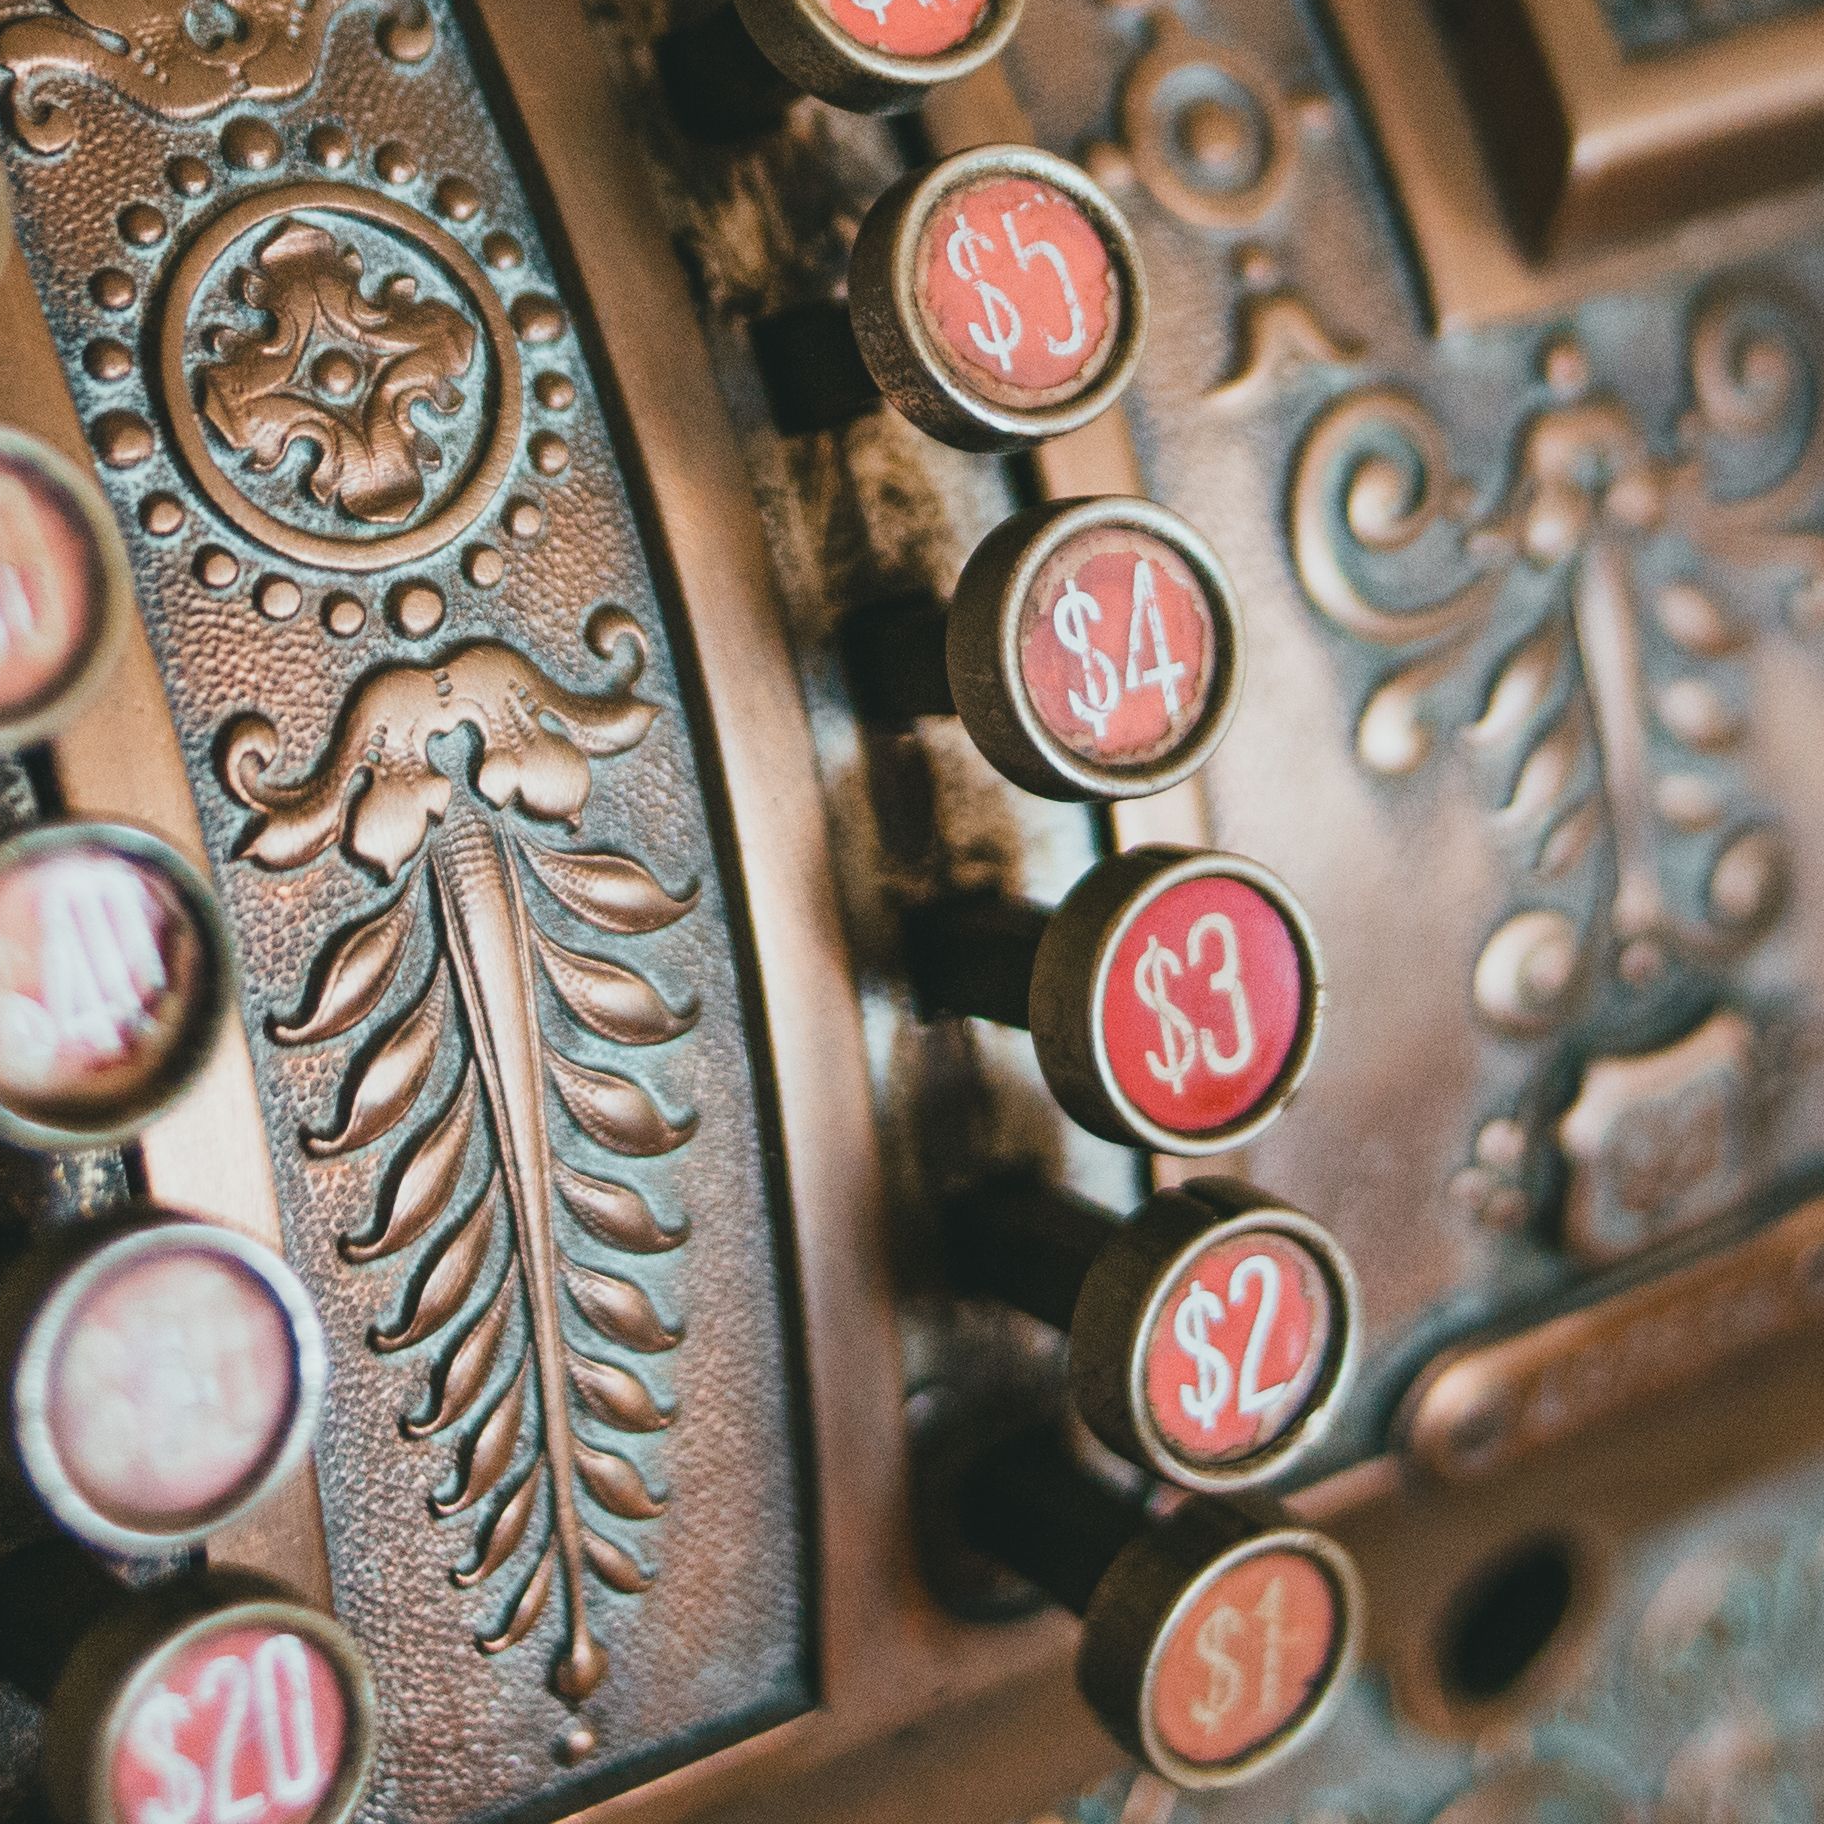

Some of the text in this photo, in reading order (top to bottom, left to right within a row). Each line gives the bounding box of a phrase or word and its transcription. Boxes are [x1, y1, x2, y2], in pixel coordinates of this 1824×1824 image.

[946, 194, 1086, 372] $5
[1053, 559, 1185, 737] $4
[1135, 912, 1255, 1095] $3
[1175, 1255, 1297, 1432] $2
[134, 1633, 317, 1824] $20
[1190, 1576, 1284, 1736] $1
